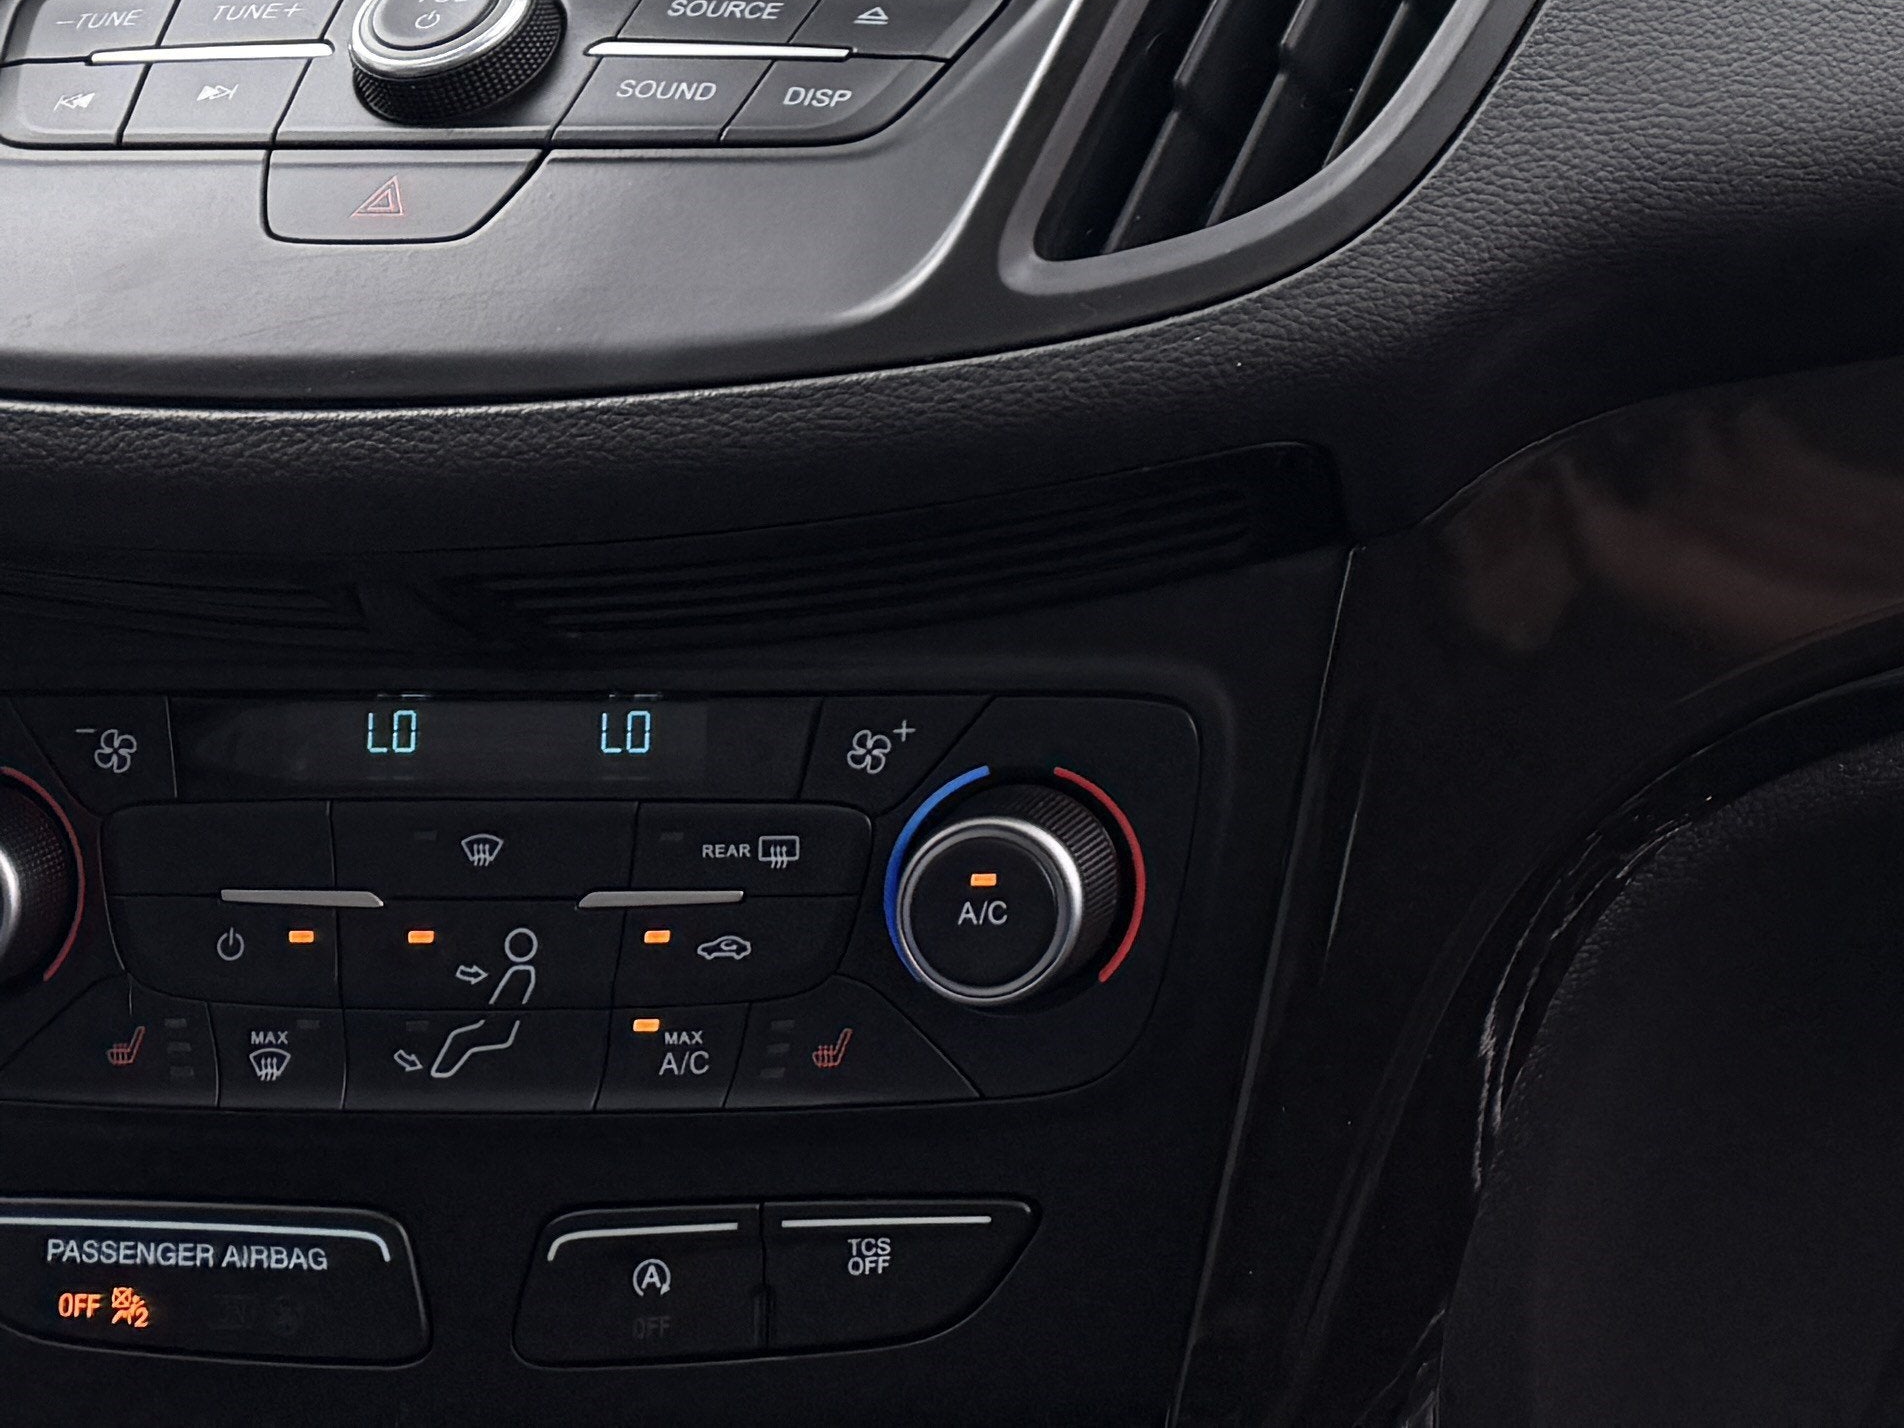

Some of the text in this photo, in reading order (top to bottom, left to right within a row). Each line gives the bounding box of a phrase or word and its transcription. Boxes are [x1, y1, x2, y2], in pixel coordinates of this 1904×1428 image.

[666, 0, 784, 20] SOURCE
[616, 79, 717, 101] SOUND
[783, 87, 852, 107] DISP
[367, 710, 417, 753] LO
[600, 710, 650, 753] LO
[702, 844, 751, 857] REAR
[957, 901, 1009, 926] A/C
[250, 1030, 289, 1044] MAX
[664, 1031, 704, 1044] MAX
[658, 1050, 710, 1076] A/C
[46, 1239, 329, 1270] PASSENGER AIRBAG
[847, 1238, 891, 1256] TCS
[847, 1256, 890, 1276] OFF
[58, 1293, 101, 1318] OFF
